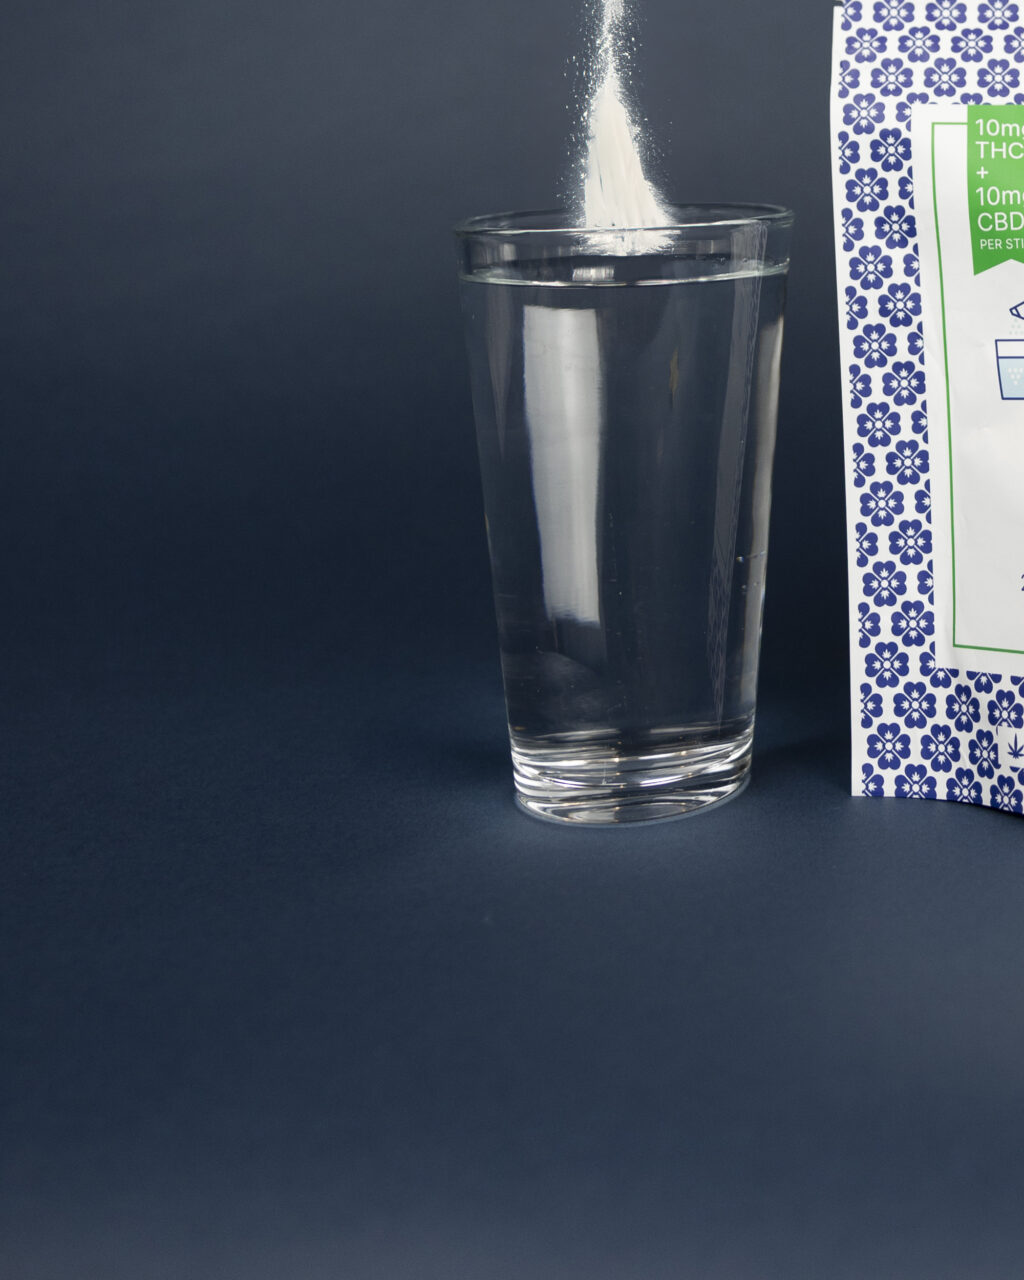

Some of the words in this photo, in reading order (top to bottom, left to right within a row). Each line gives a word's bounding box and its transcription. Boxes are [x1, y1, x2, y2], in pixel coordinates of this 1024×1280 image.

[975, 141, 1024, 160] THC
[976, 167, 989, 179] +
[977, 211, 1024, 232] CBD
[980, 238, 1003, 250] PER
